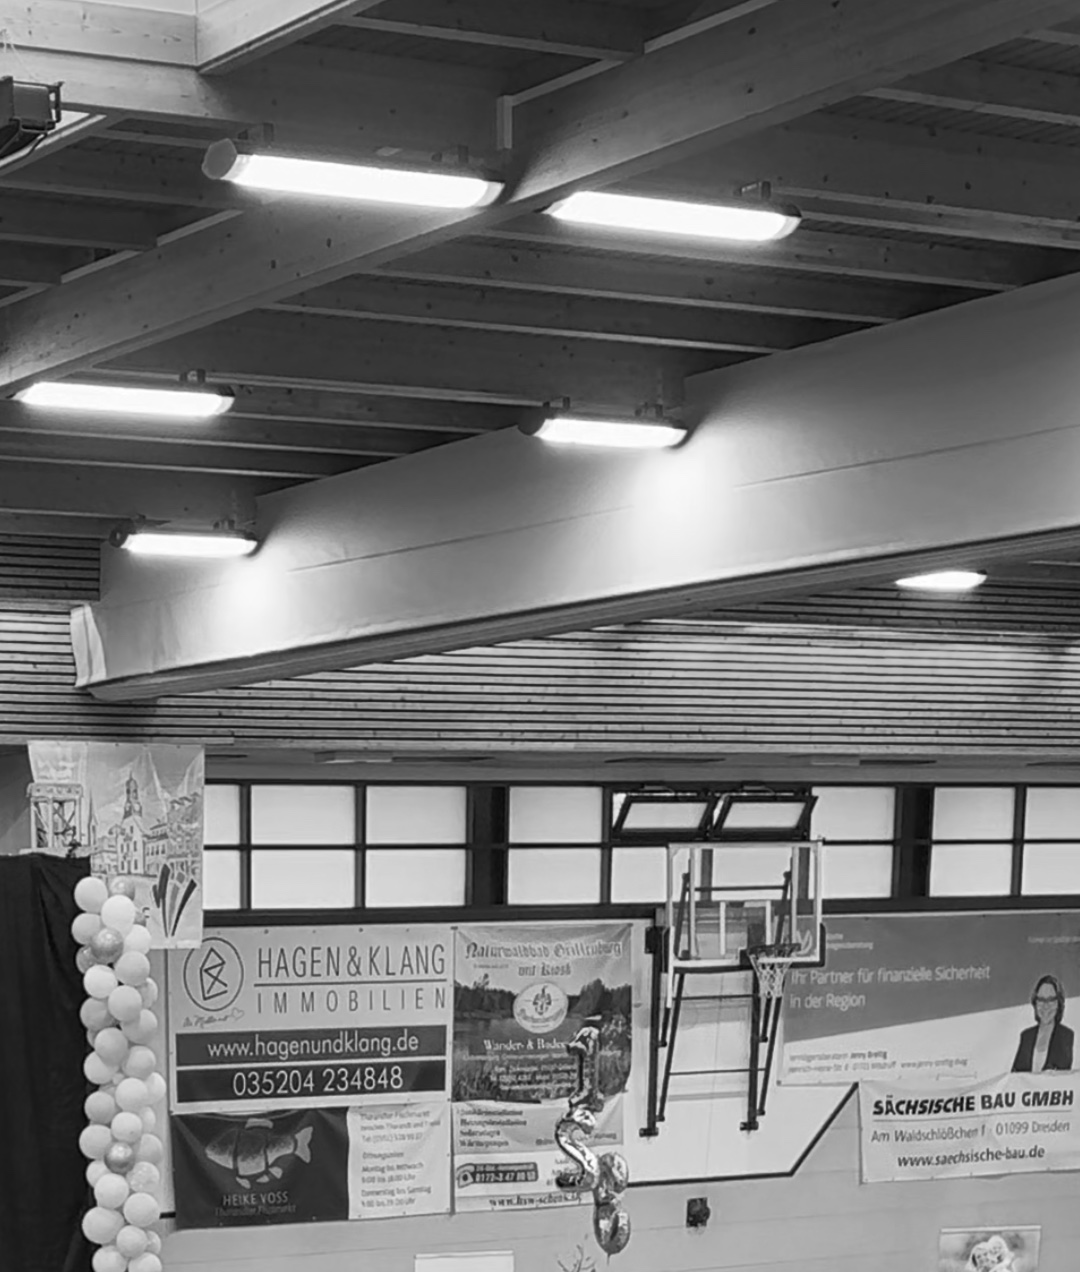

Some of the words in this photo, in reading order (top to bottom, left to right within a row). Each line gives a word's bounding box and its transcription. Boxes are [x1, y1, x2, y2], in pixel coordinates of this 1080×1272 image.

[790, 968, 807, 985] Ihr
[809, 968, 855, 985] Partner
[856, 966, 874, 983] für
[877, 965, 933, 983] finanzielle
[934, 965, 991, 982] Sicherheit
[257, 987, 446, 1014] IMMOBILIEN
[789, 995, 802, 1008] in
[804, 994, 824, 1008] der
[825, 993, 866, 1011] Region
[207, 1028, 419, 1060] www.hagenundklang.de
[232, 1069, 315, 1096] 035204
[322, 1065, 404, 1092] 234848
[872, 1095, 976, 1116] SÄCHSISCHE
[980, 1091, 1016, 1110] BAU
[1021, 1090, 1074, 1107] GMBH
[871, 1130, 890, 1143] Am
[894, 1125, 979, 1143] Waldschlößchen
[995, 1121, 1029, 1136] 01099
[1031, 1119, 1071, 1134] Dresden
[897, 1144, 1046, 1167] www.saechsische-bau.de
[222, 1193, 257, 1206] HEIKE
[260, 1190, 288, 1204] VOSS
